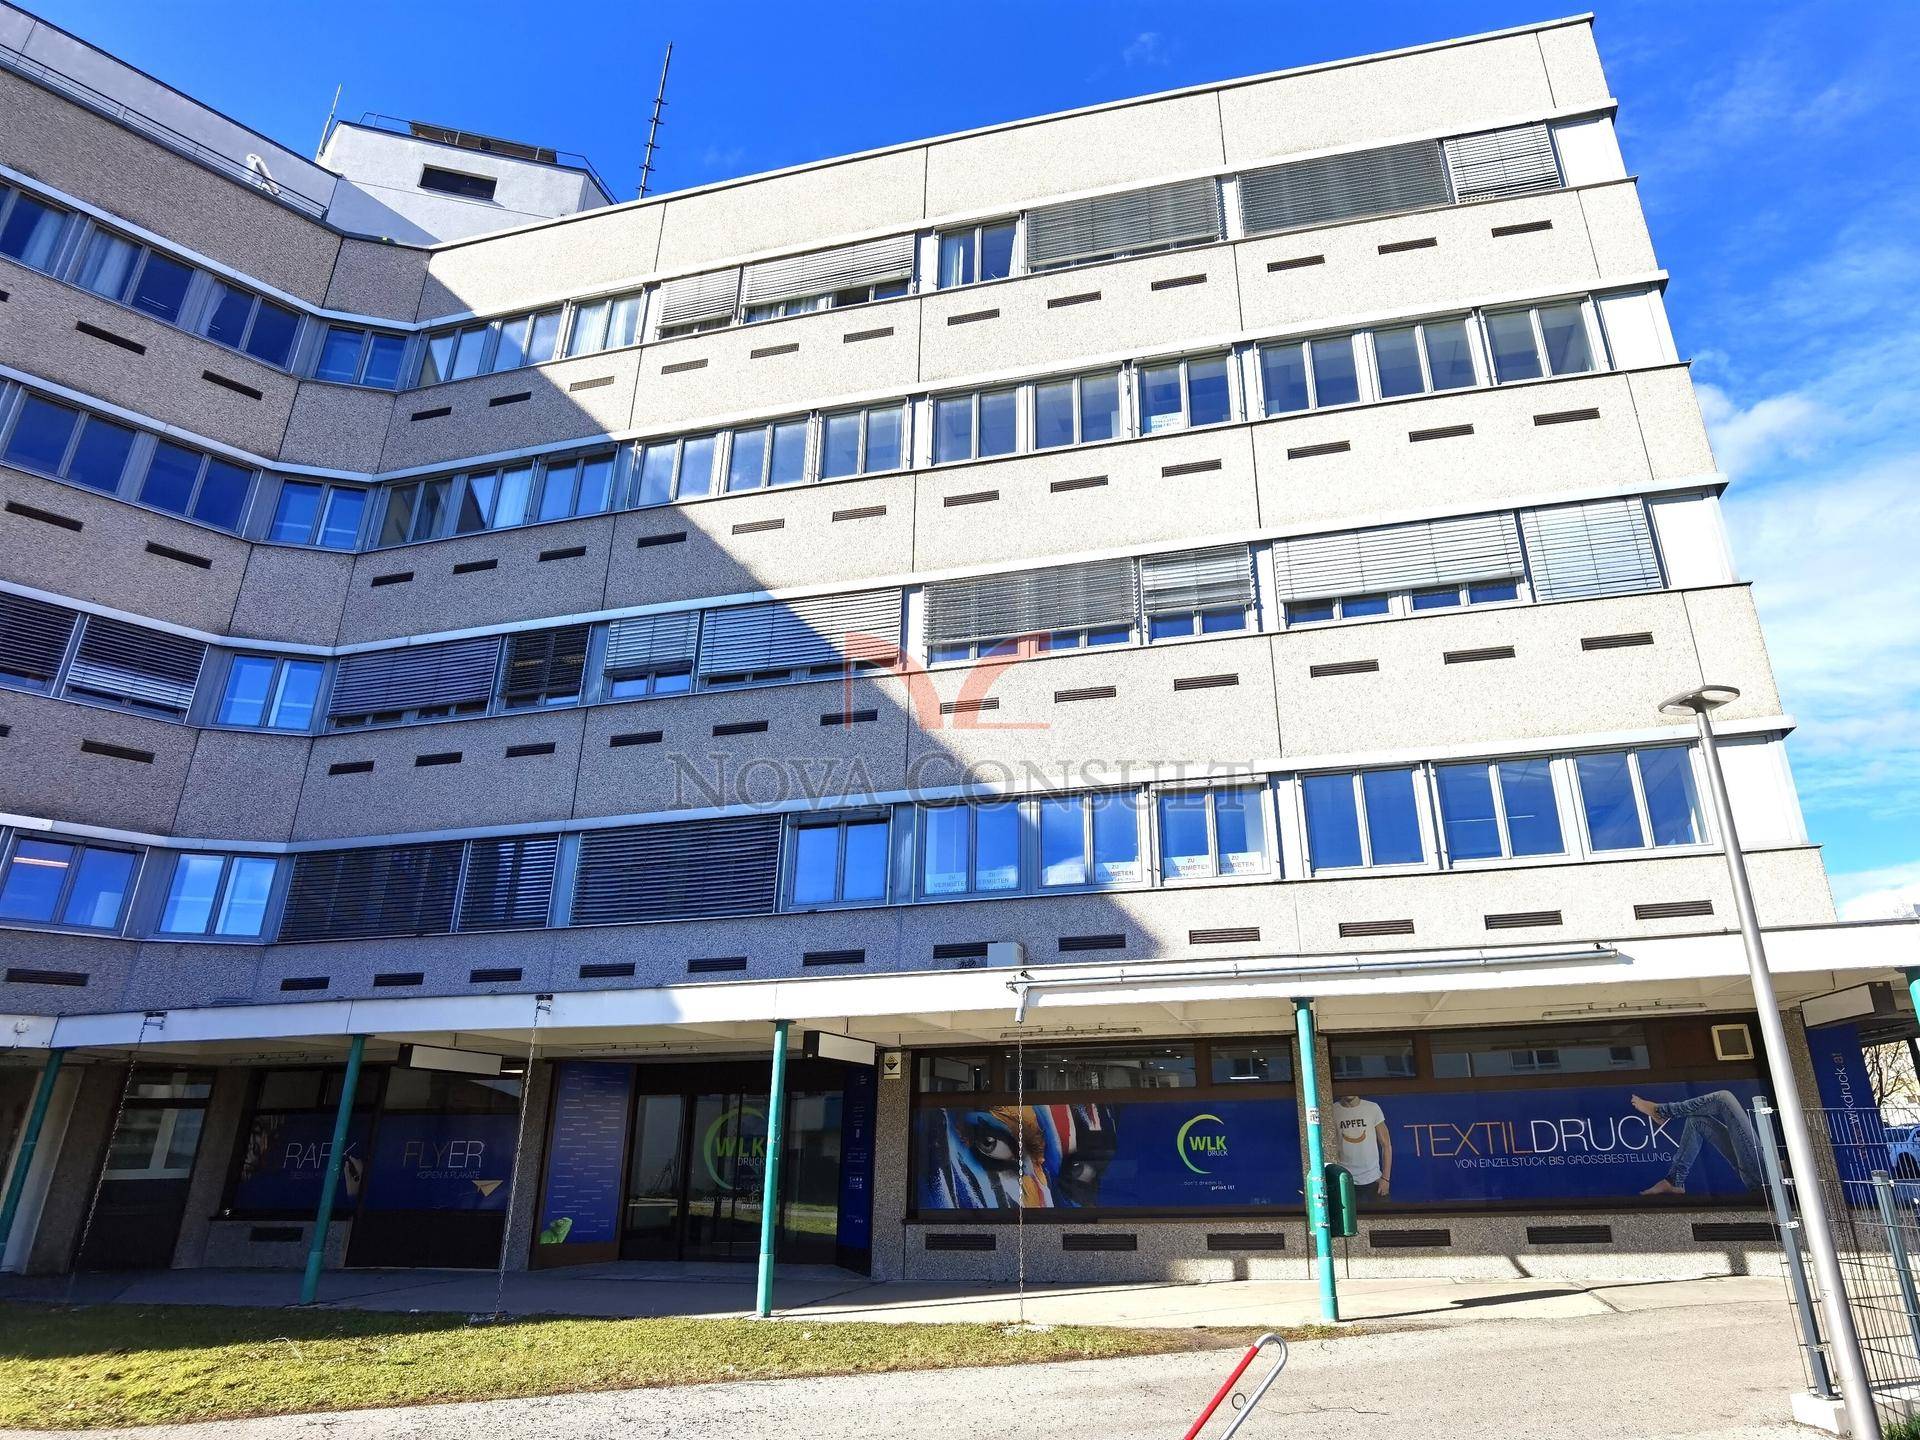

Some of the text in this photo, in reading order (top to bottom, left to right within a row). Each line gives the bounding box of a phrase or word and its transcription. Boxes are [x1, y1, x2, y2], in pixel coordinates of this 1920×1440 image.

[1340, 1118, 1367, 1130] APFEL
[1189, 1135, 1228, 1150] WLK
[1403, 1115, 1681, 1157] TEXTILDRUCK
[402, 1140, 486, 1169] FLYER
[716, 1137, 766, 1157] WLK
[737, 1157, 766, 1166] DRUCK
[1455, 1159, 1477, 1168] VON
[1548, 1155, 1565, 1166] BIS
[1567, 1151, 1672, 1165] GROSSBESTELLUNG
